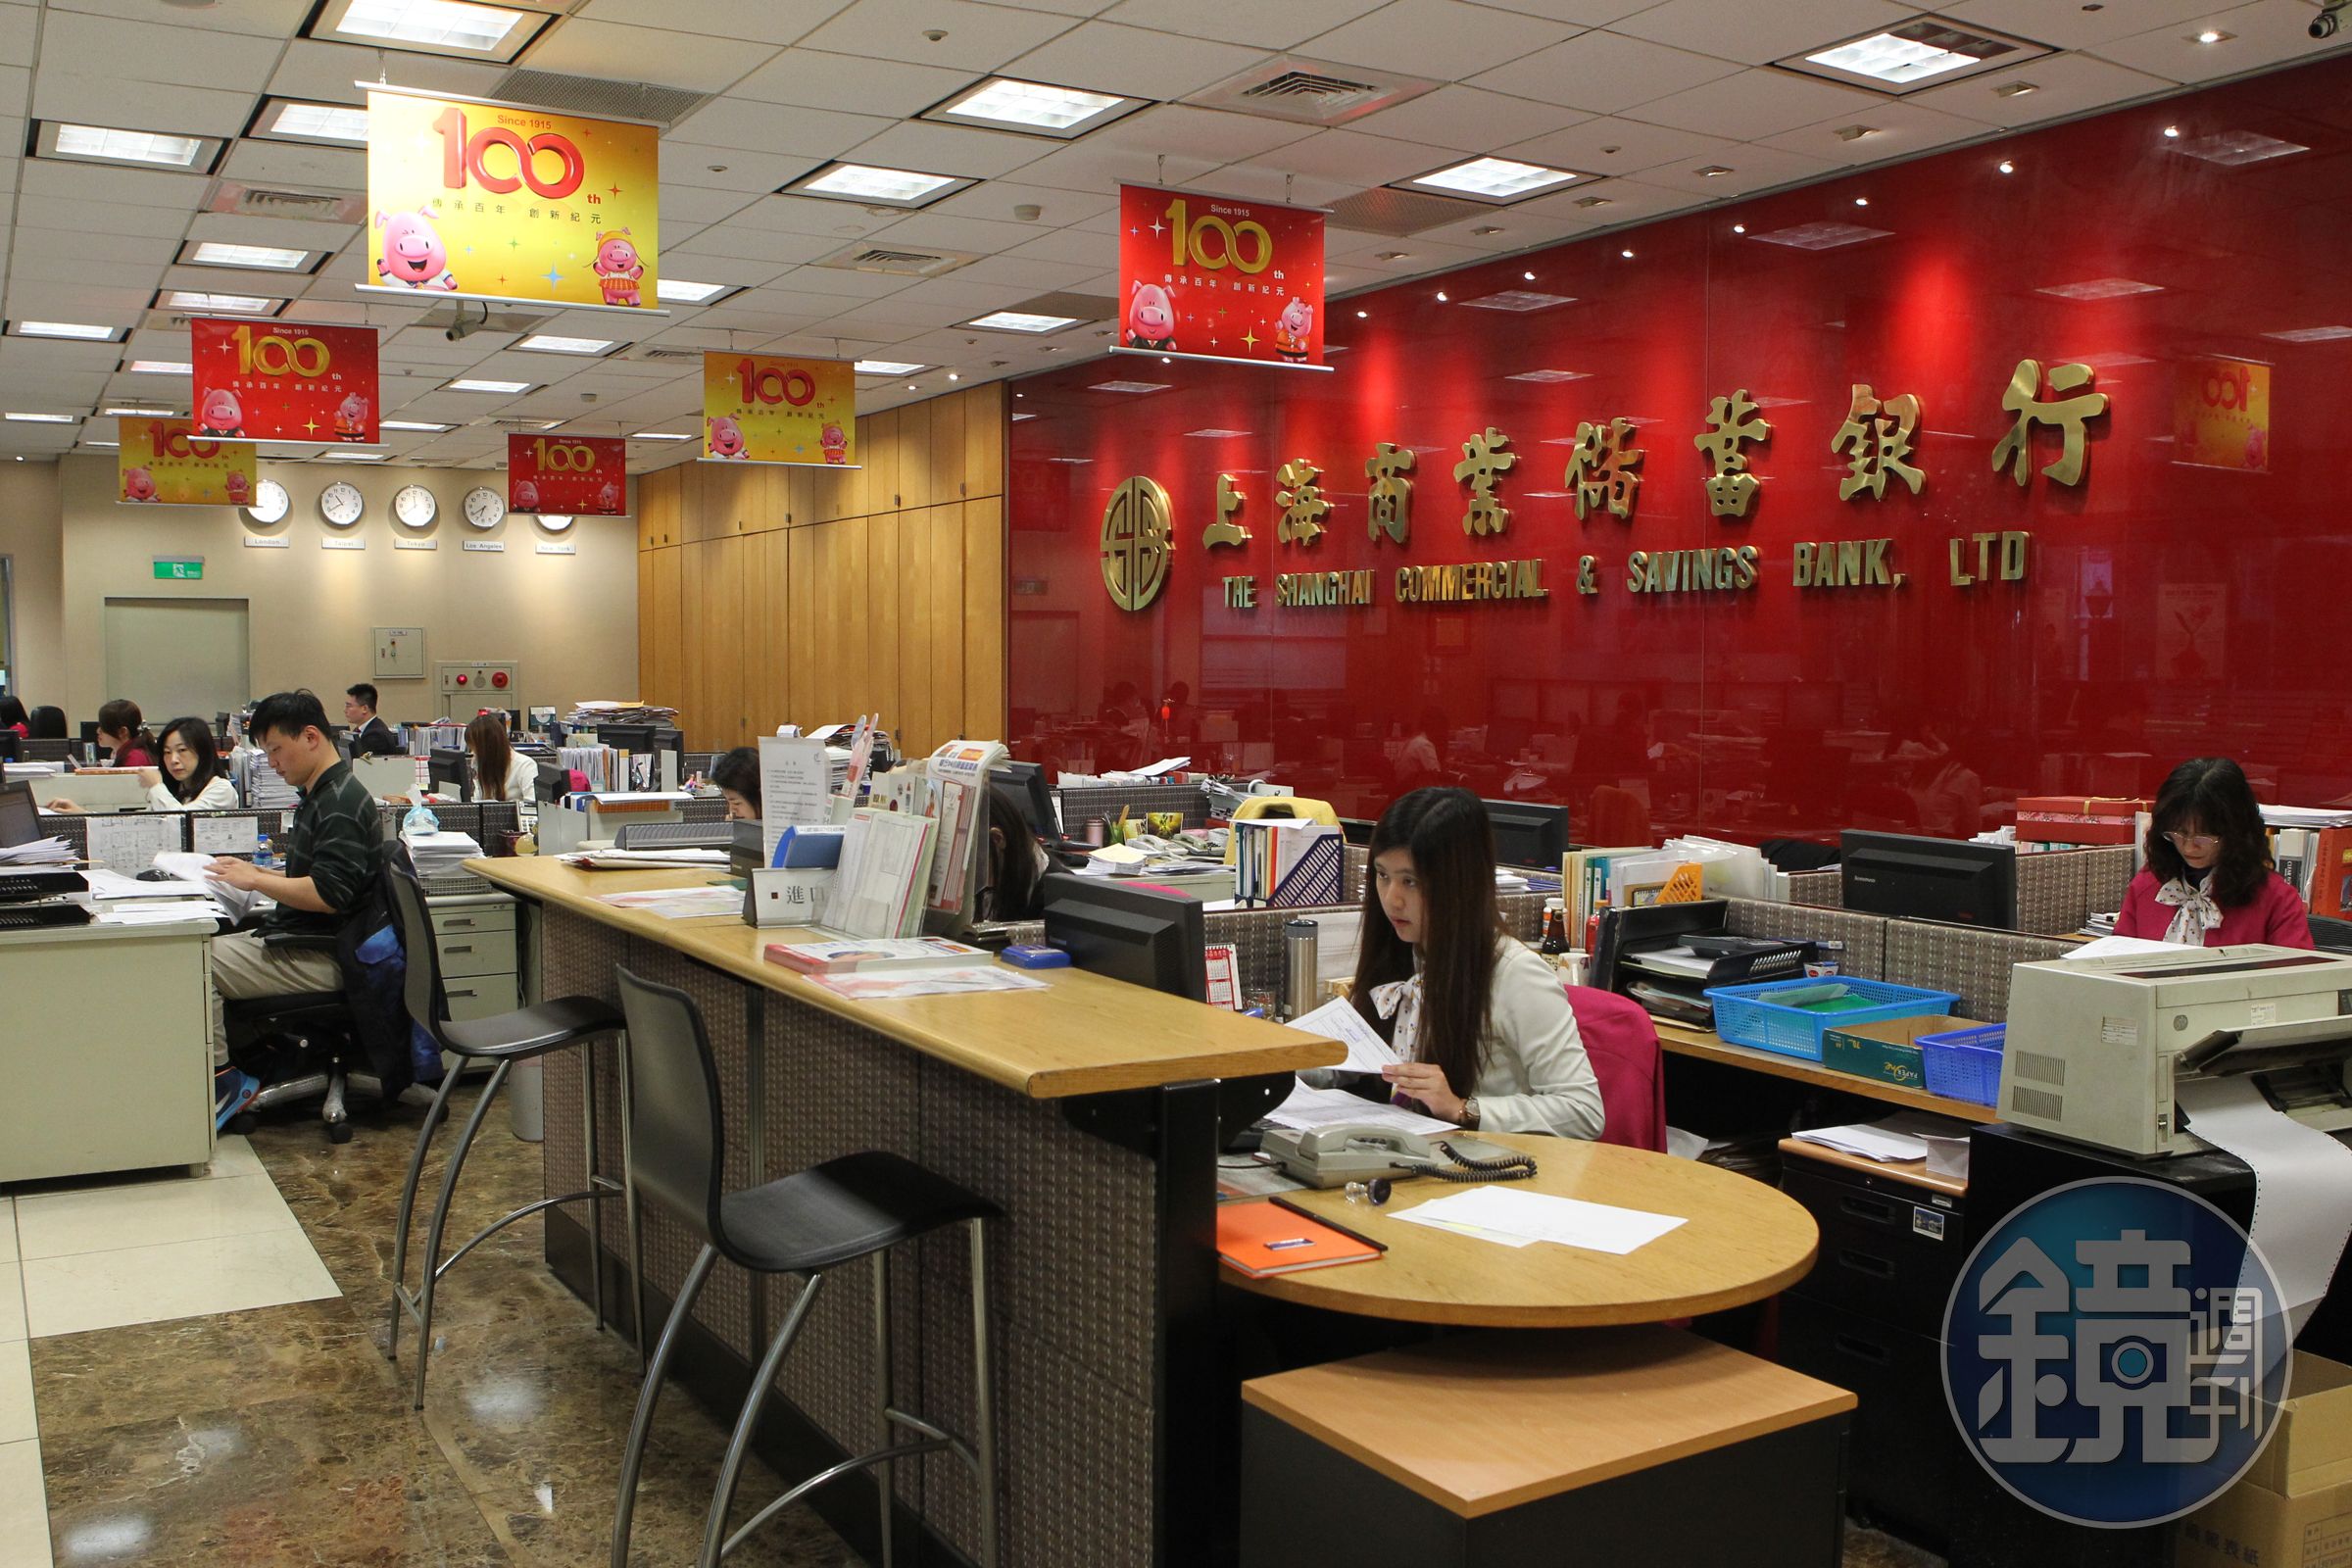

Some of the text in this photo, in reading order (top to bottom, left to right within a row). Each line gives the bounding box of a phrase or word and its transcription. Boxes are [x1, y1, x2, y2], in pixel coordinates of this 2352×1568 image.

[497, 114, 552, 130] Since 1915
[432, 107, 585, 200] 100
[528, 207, 602, 224] 創新紀元
[586, 193, 602, 205] th
[1210, 204, 1250, 218] Since 1915
[1164, 198, 1273, 274] 100
[1273, 270, 1285, 280] th
[272, 326, 293, 335] Since
[231, 324, 330, 378] 100
[736, 358, 816, 407] 100
[532, 438, 596, 472] 100
[1201, 357, 2110, 549] 上海商業儲蓄銀行
[1221, 530, 2033, 609] THE SHANGHAI COMMERCIAL & SAVINGS BANK, LTD
